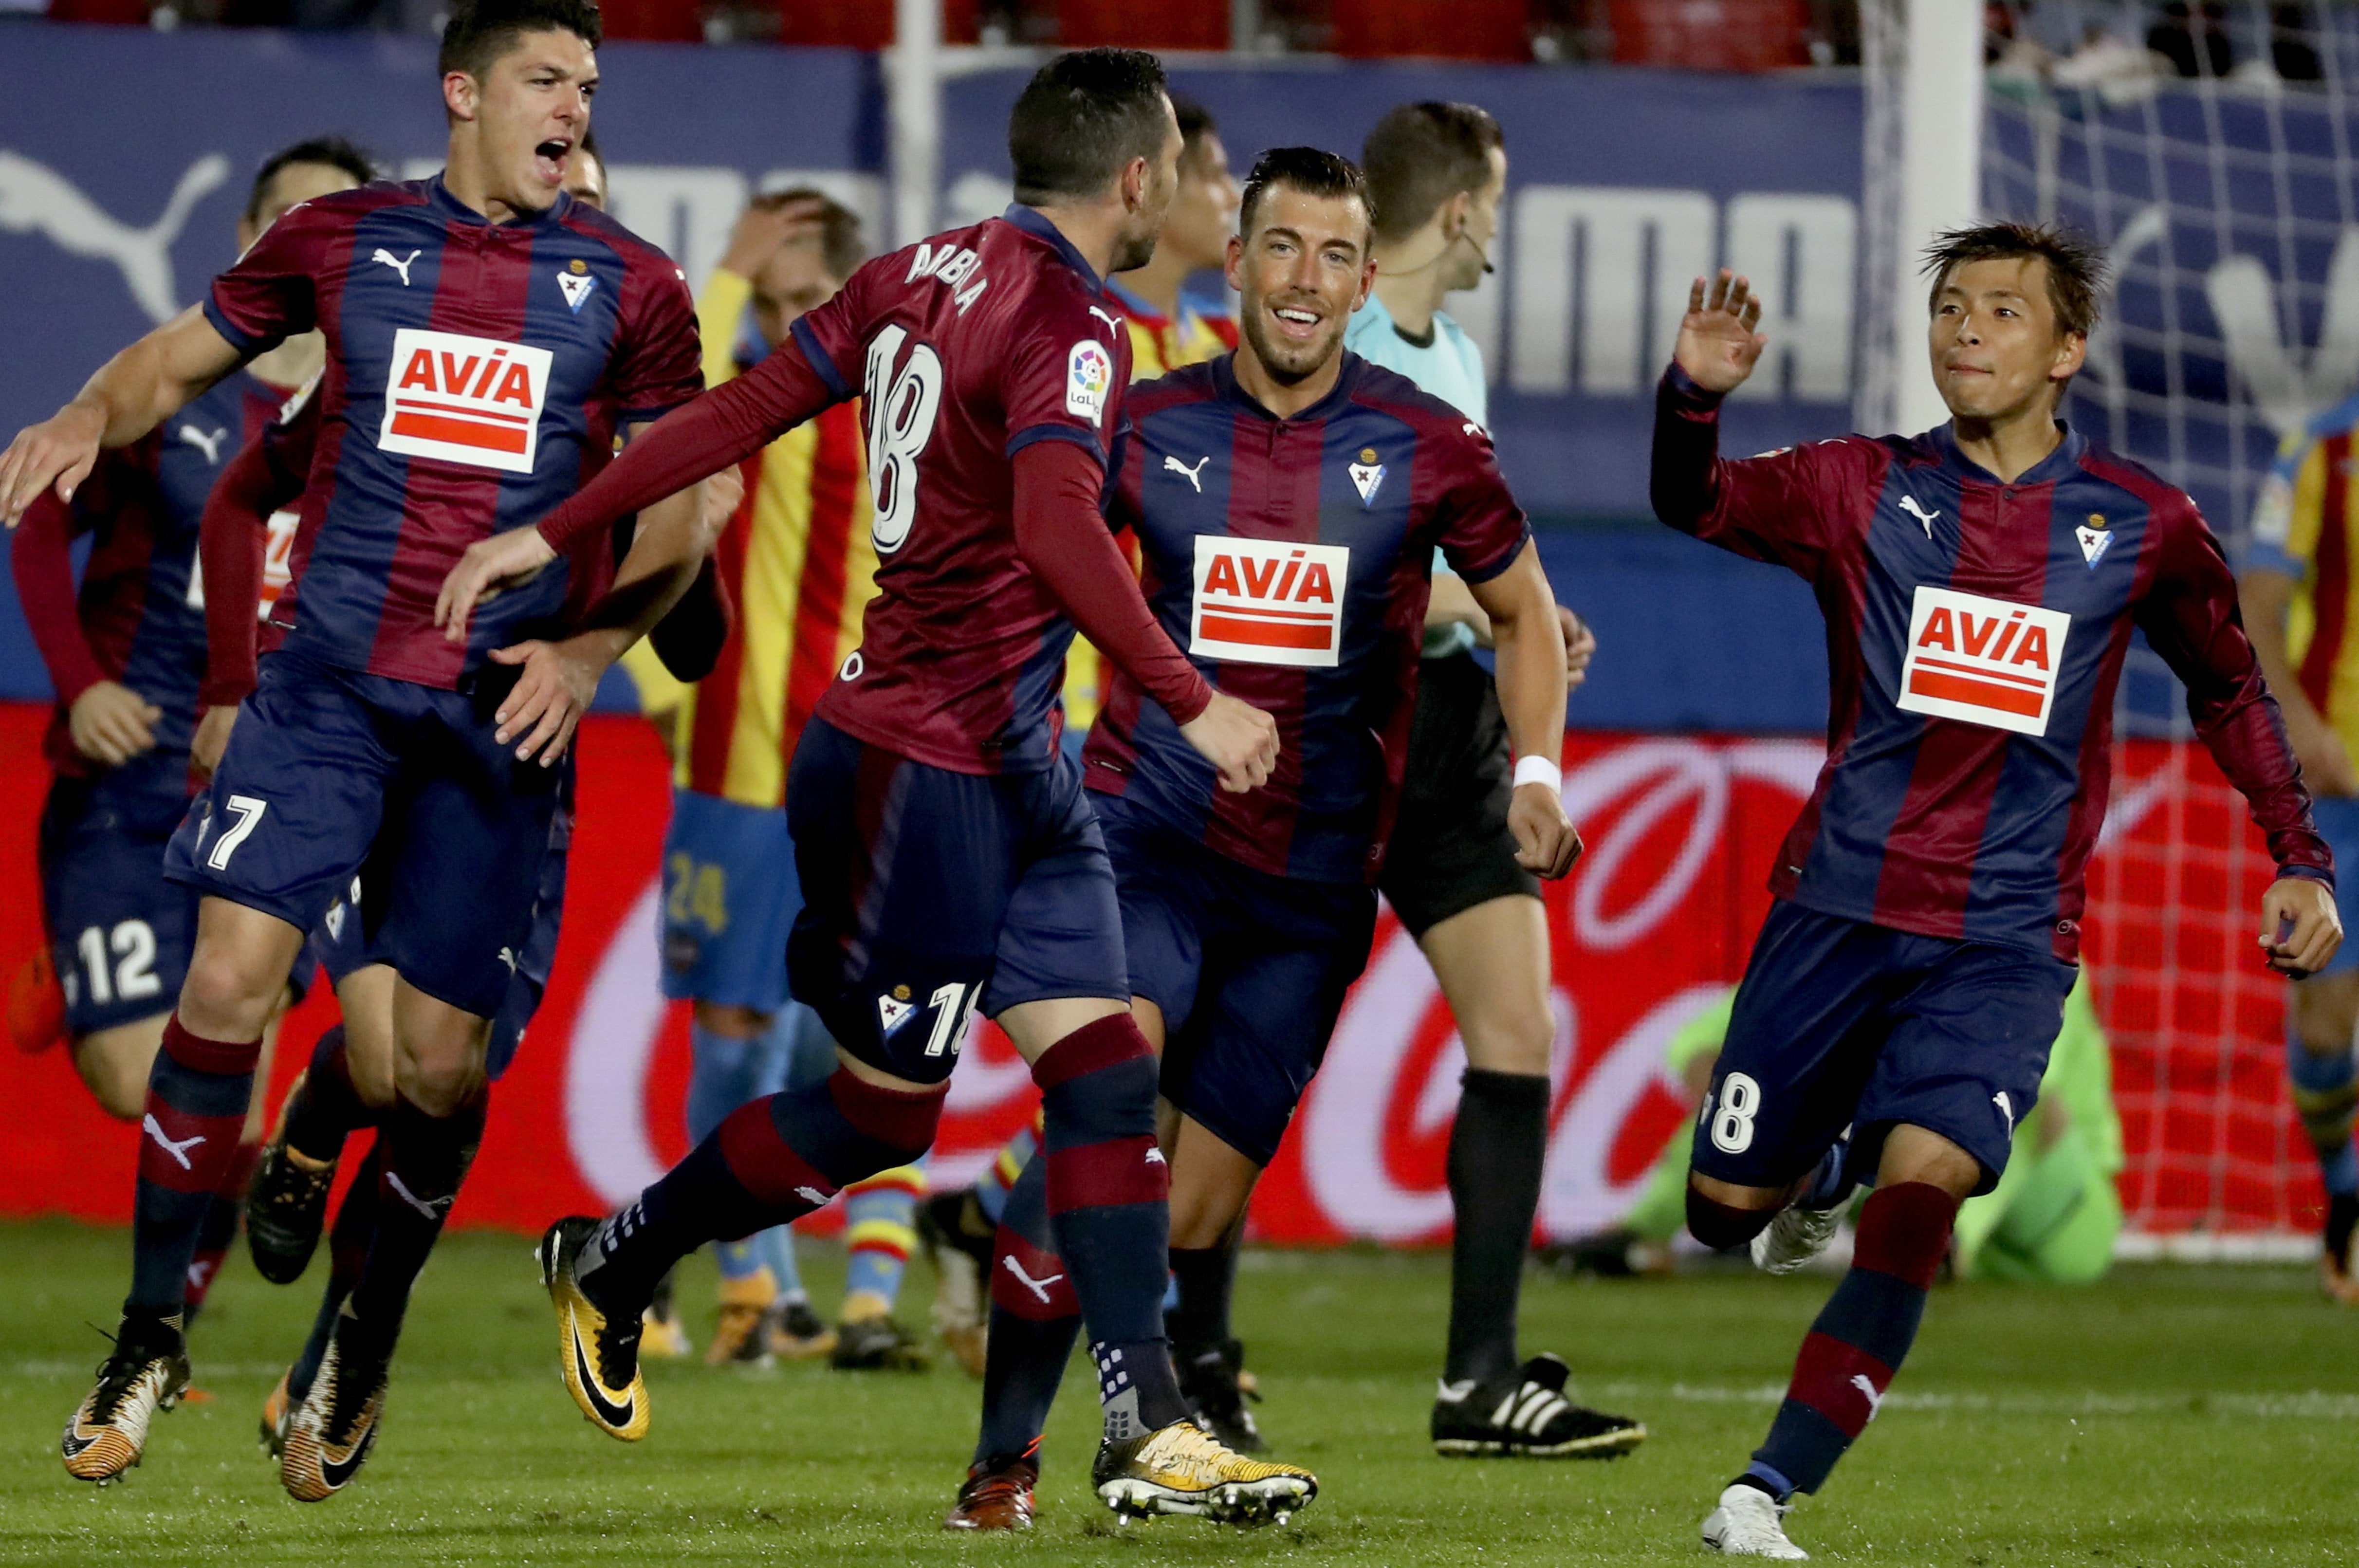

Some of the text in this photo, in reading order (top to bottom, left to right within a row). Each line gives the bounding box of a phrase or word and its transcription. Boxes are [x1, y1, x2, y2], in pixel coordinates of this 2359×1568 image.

[864, 323, 943, 553] 18
[207, 794, 266, 870] 7
[669, 853, 727, 933] 24
[77, 919, 162, 1004] 12
[1711, 1071, 1761, 1154] 8
